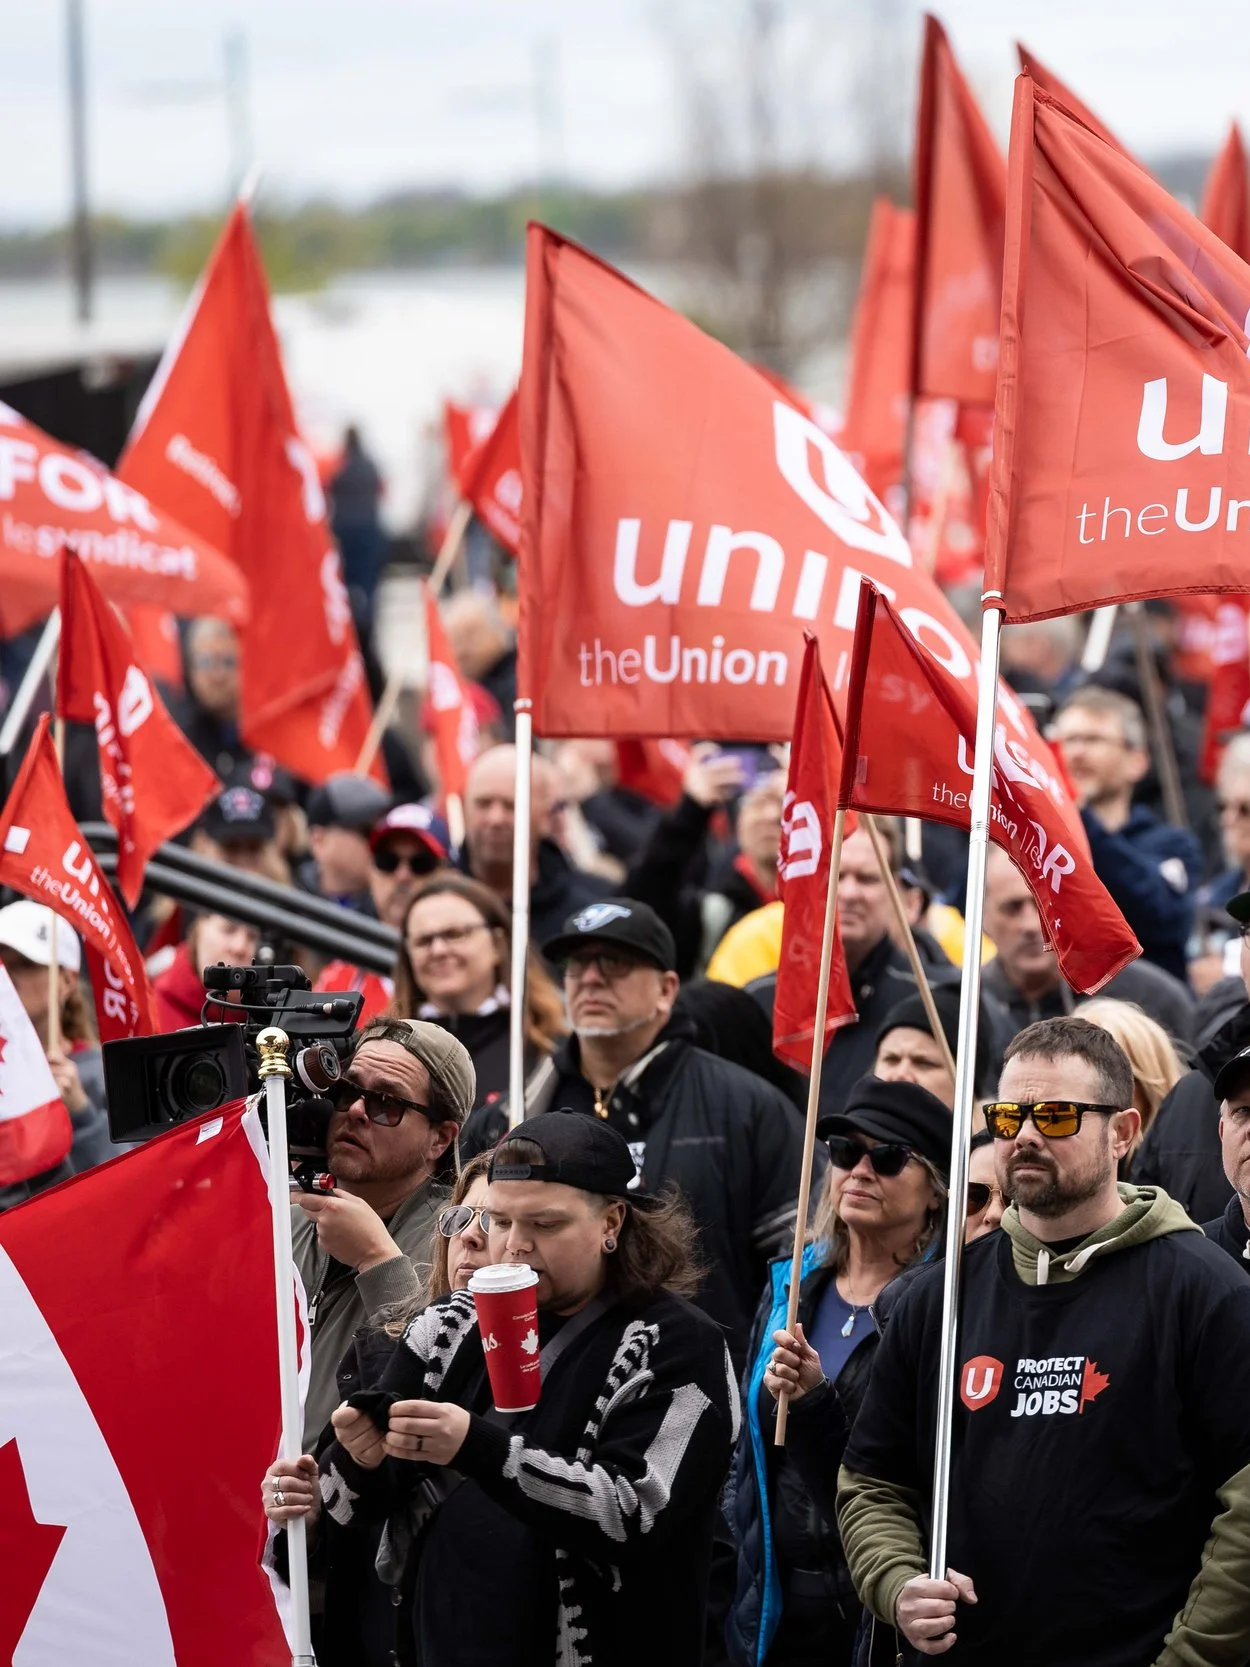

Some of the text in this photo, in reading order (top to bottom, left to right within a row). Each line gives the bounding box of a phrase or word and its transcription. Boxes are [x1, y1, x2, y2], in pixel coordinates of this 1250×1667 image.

[0, 434, 160, 533] FOR
[578, 635, 788, 688] theUnion
[932, 782, 1018, 840] thenion
[1014, 1373, 1082, 1389] CANADIAN
[1016, 1356, 1085, 1374] PROTECT
[1010, 1389, 1079, 1417] JOBS
